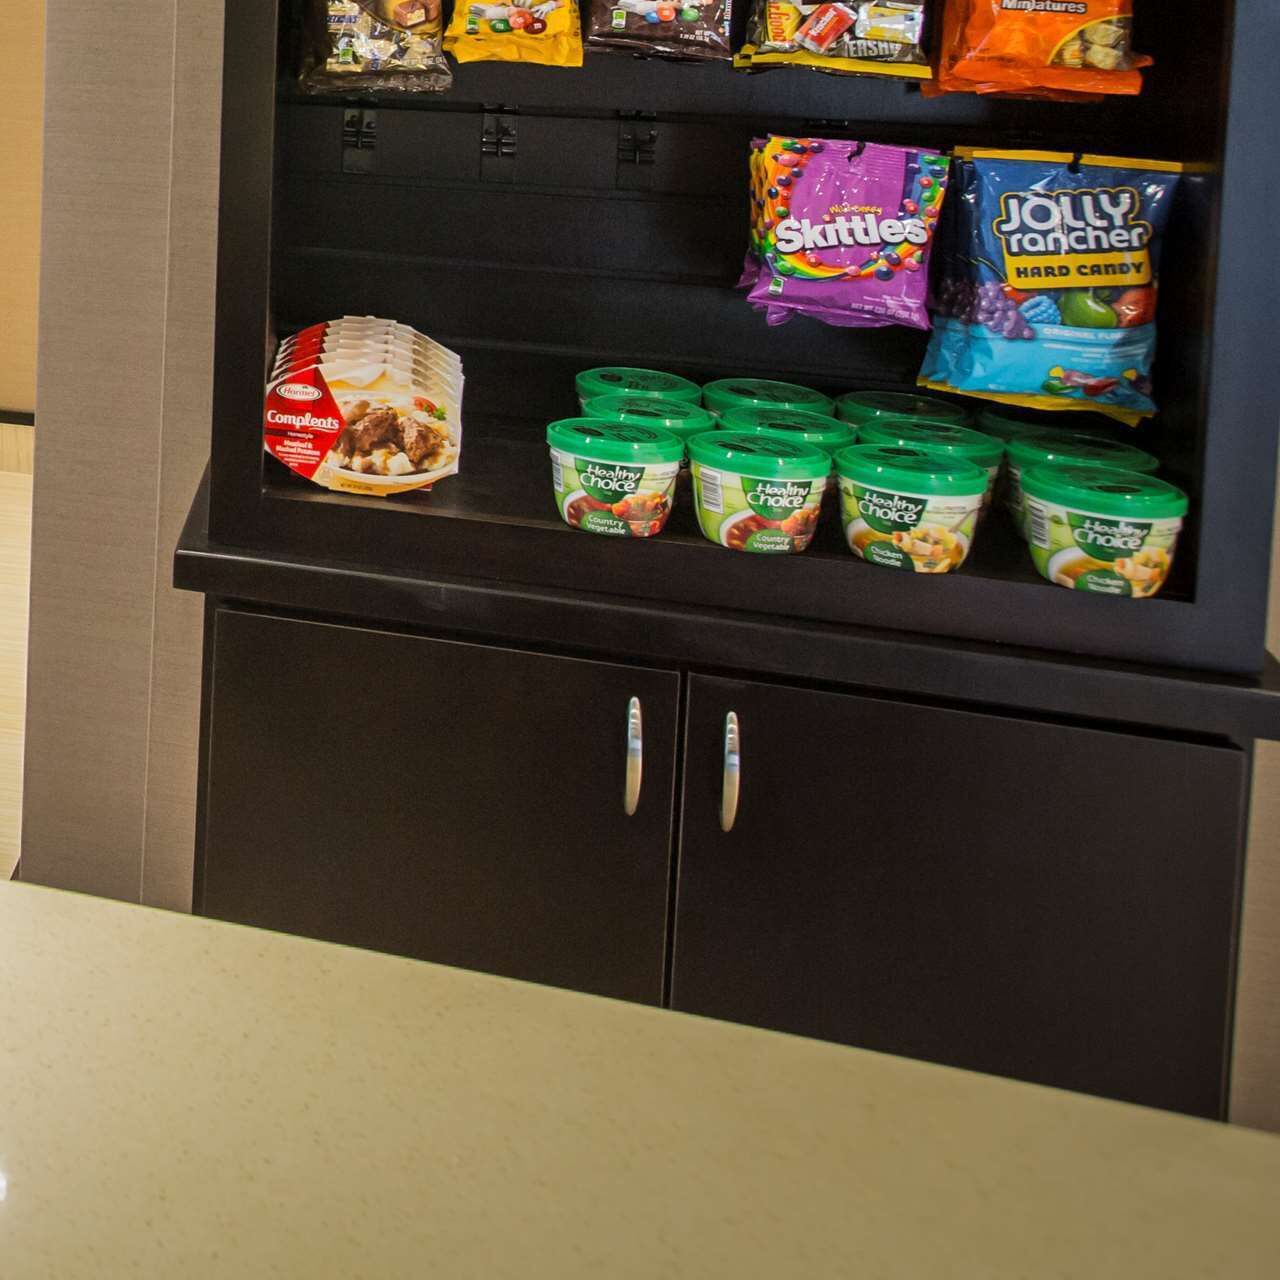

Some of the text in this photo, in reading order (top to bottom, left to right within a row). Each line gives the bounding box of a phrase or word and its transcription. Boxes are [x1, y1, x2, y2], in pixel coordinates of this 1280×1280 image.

[1000, 193, 1132, 232] JOLLY
[775, 214, 928, 253] Skittles
[1009, 227, 1146, 253] rancher
[1016, 265, 1071, 278] HARD
[283, 386, 319, 398] Hormel
[267, 408, 341, 430] Compleats
[587, 464, 641, 482] Healthy
[580, 475, 637, 492] Choice
[756, 483, 809, 498] Healthy
[747, 491, 804, 508] Choice
[864, 491, 923, 512] Healthy
[588, 514, 624, 528] Country
[858, 500, 918, 525] Choice
[586, 523, 627, 535] Vegetable
[1084, 521, 1151, 539] Healthy
[753, 541, 790, 552] Vegetable
[756, 534, 790, 544] Country
[1072, 528, 1142, 552] Choice
[870, 546, 903, 560] Chicken
